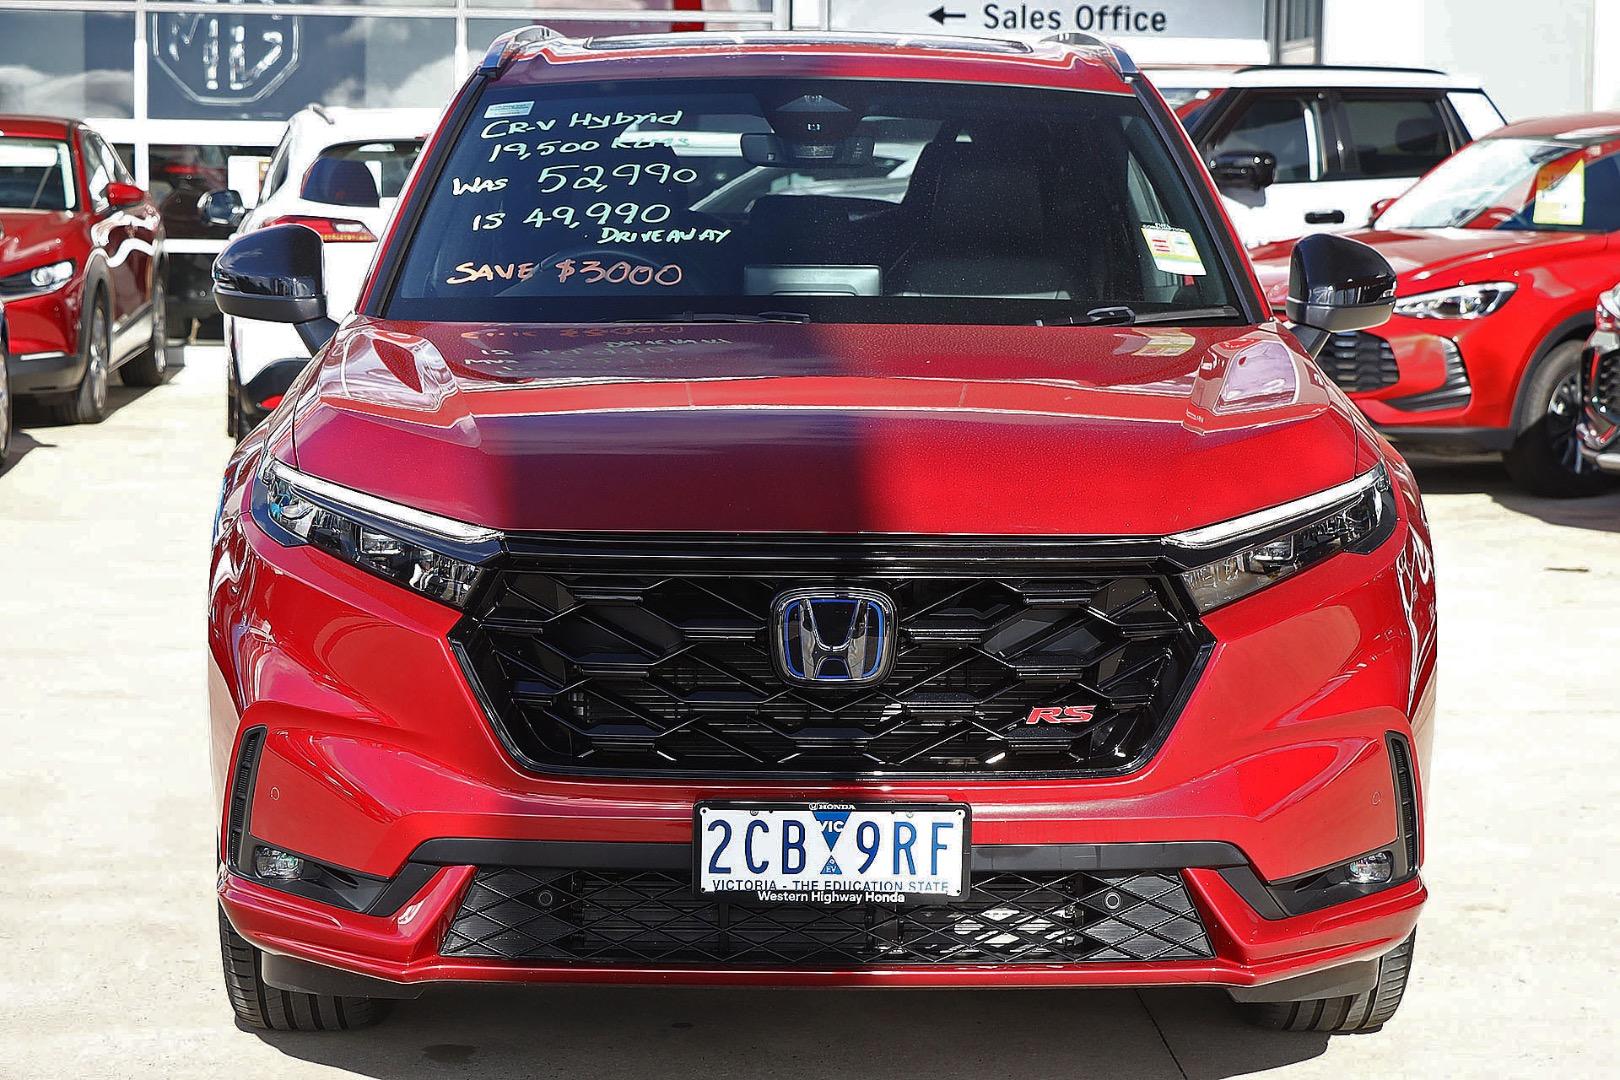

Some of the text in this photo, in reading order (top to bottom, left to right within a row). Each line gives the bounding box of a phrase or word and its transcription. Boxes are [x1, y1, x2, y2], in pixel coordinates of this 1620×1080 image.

[984, 4, 1168, 31] Sales Office
[488, 139, 600, 163] 19,500
[537, 163, 698, 193] 52,990
[522, 202, 671, 229] 49,990
[555, 259, 682, 286] $3000
[1025, 704, 1097, 725] RS
[816, 820, 845, 833] VIC
[707, 819, 954, 876] 2CB 9RF
[712, 879, 777, 891] VICTORIA
[792, 880, 819, 891] THE
[824, 880, 903, 892] EDUCATION
[908, 881, 949, 892] STATE
[757, 891, 905, 905] Western Highway Honda
